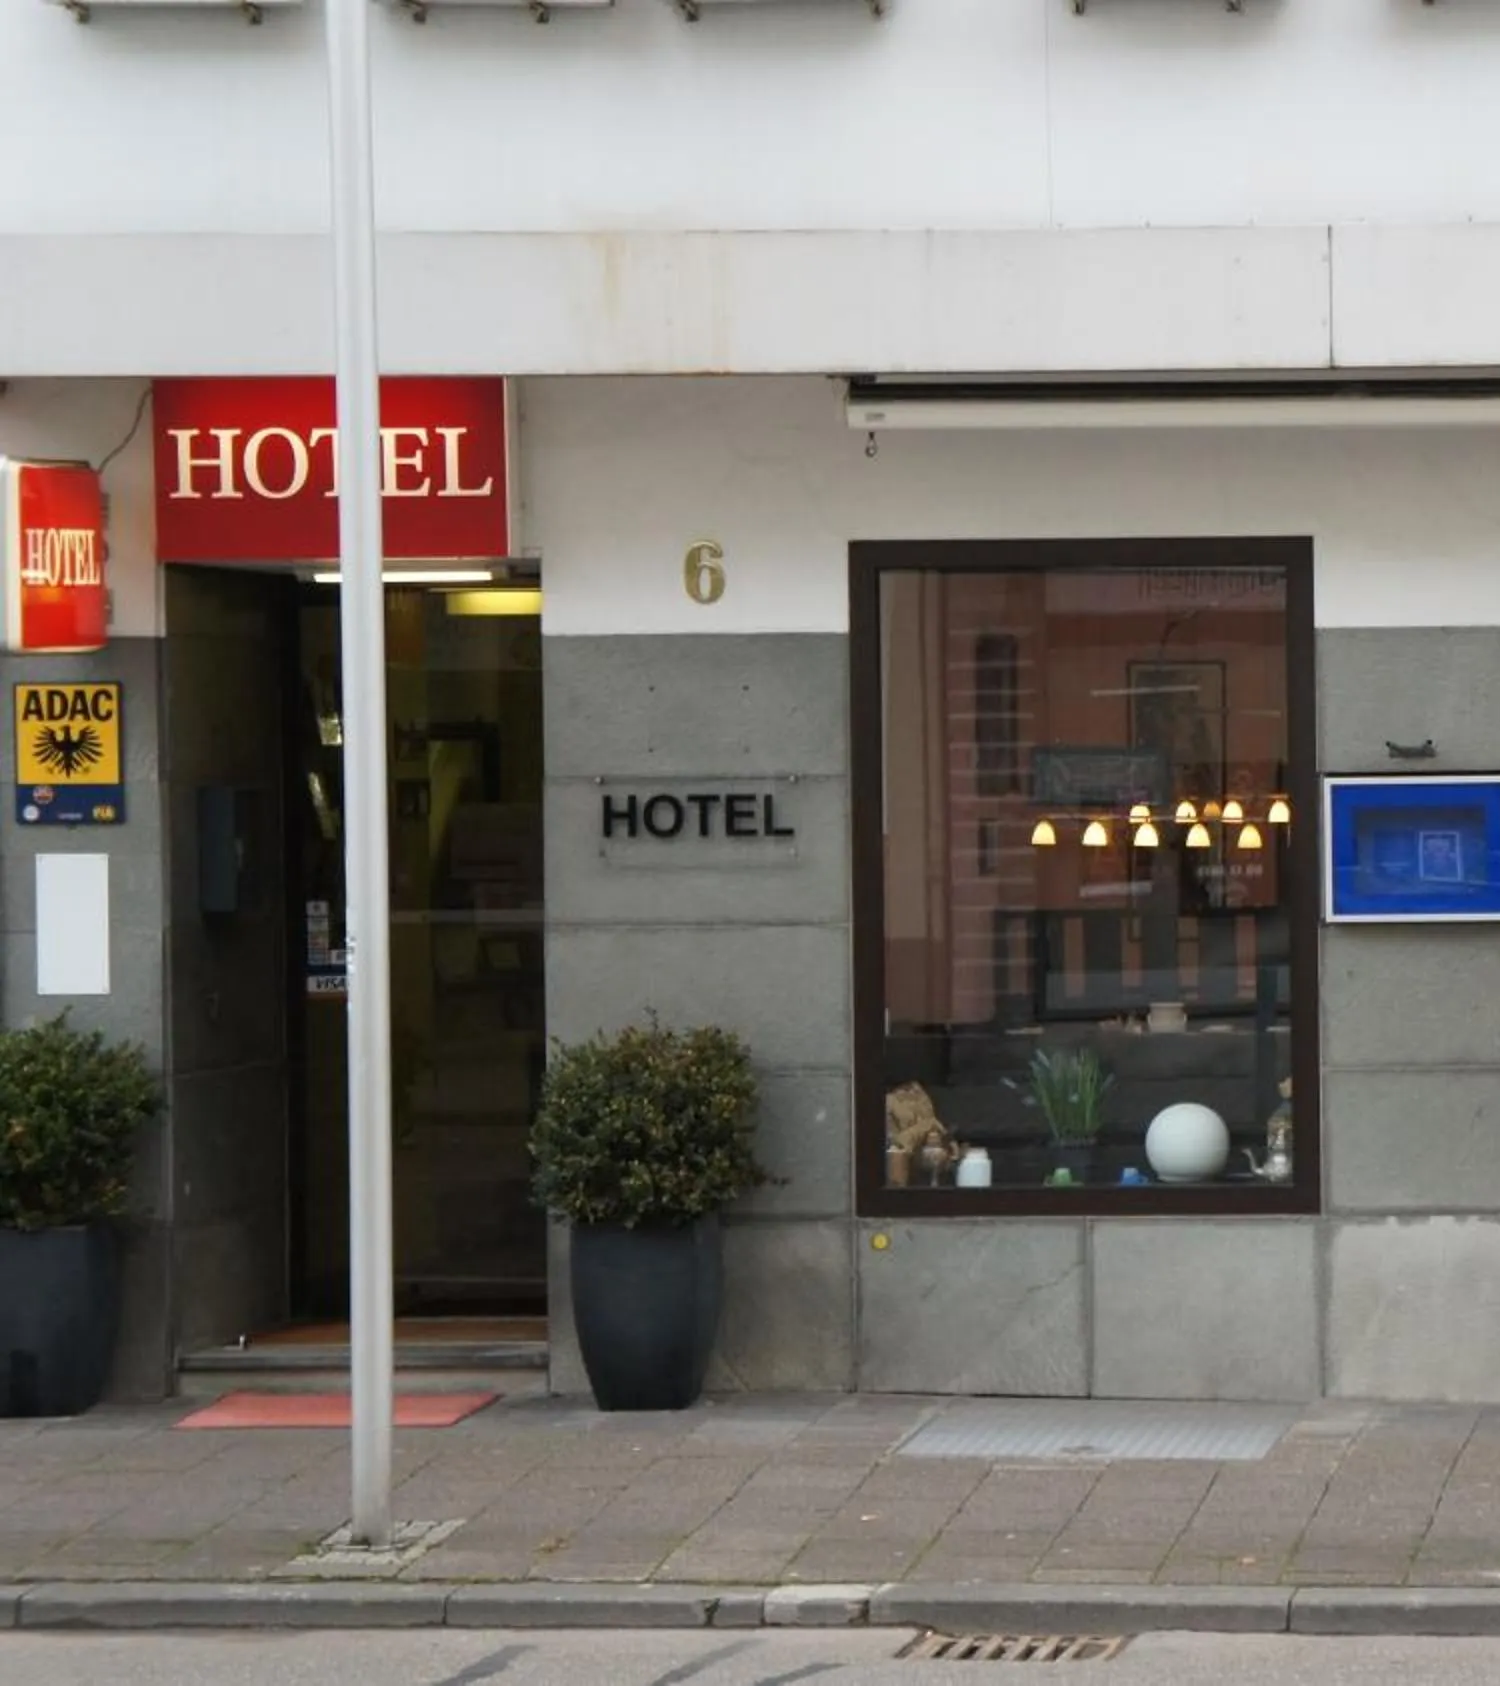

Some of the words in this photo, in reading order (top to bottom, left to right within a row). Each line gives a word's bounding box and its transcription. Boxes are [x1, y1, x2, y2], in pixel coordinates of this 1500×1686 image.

[24, 527, 100, 586] HOTEL
[683, 540, 726, 605] 6
[22, 689, 114, 722] ADAC
[602, 793, 796, 838] HOTEL
